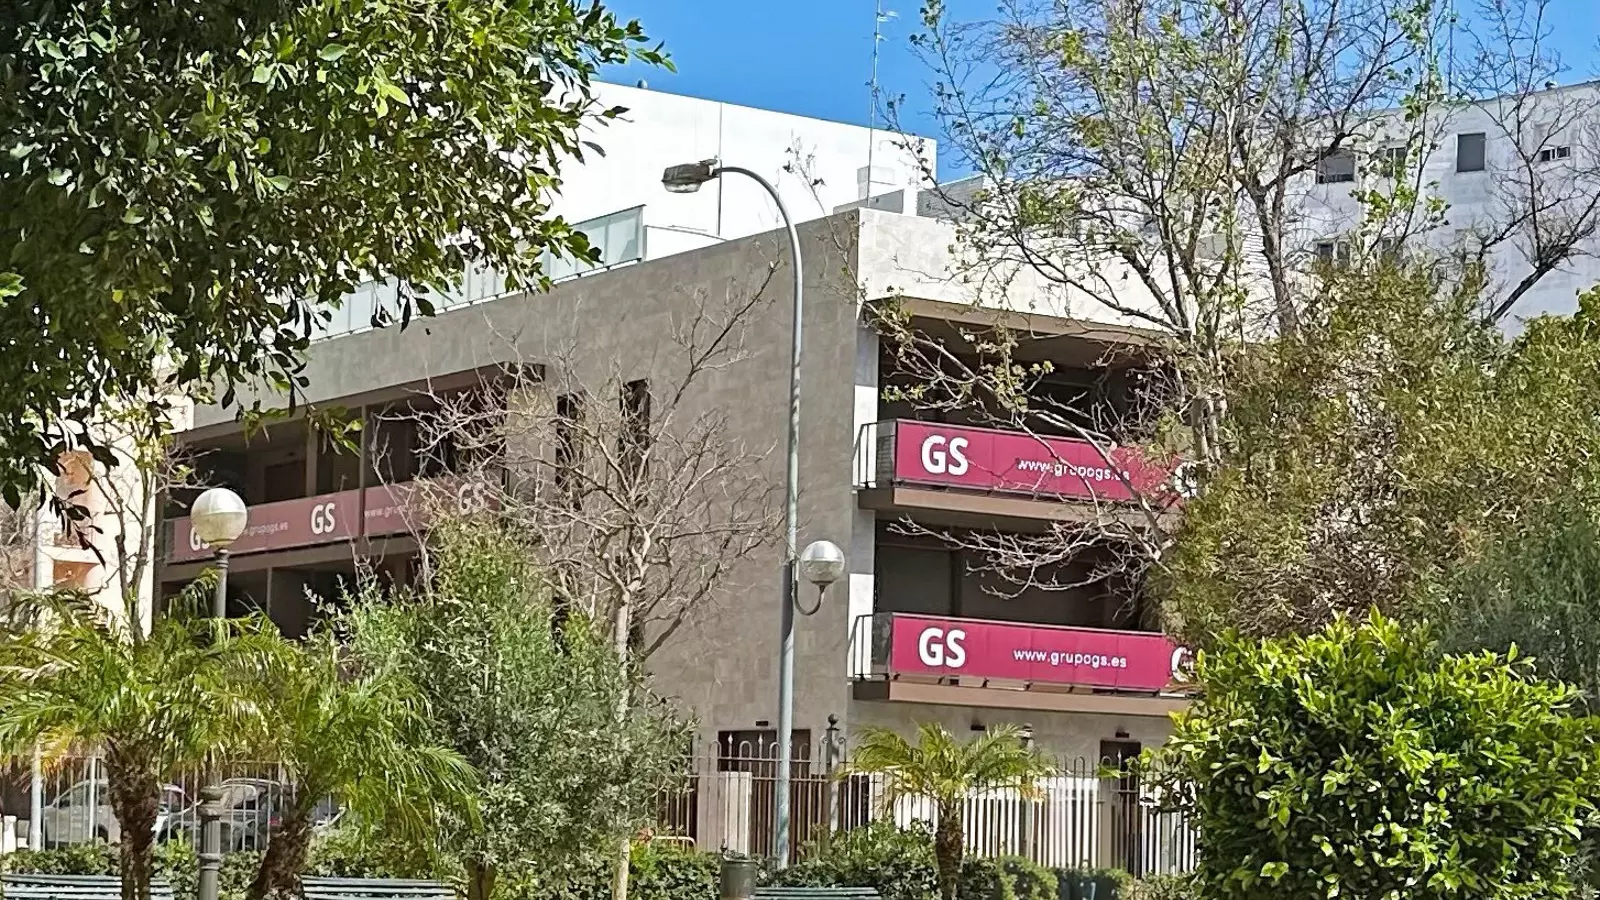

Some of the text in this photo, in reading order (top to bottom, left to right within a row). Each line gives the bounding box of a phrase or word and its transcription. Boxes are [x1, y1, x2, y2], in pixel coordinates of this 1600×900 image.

[921, 434, 969, 475] GS
[1174, 461, 1195, 496] G
[311, 502, 336, 535] GS
[458, 482, 485, 515] GS
[918, 627, 1194, 683] GS www.grupogs.es G
